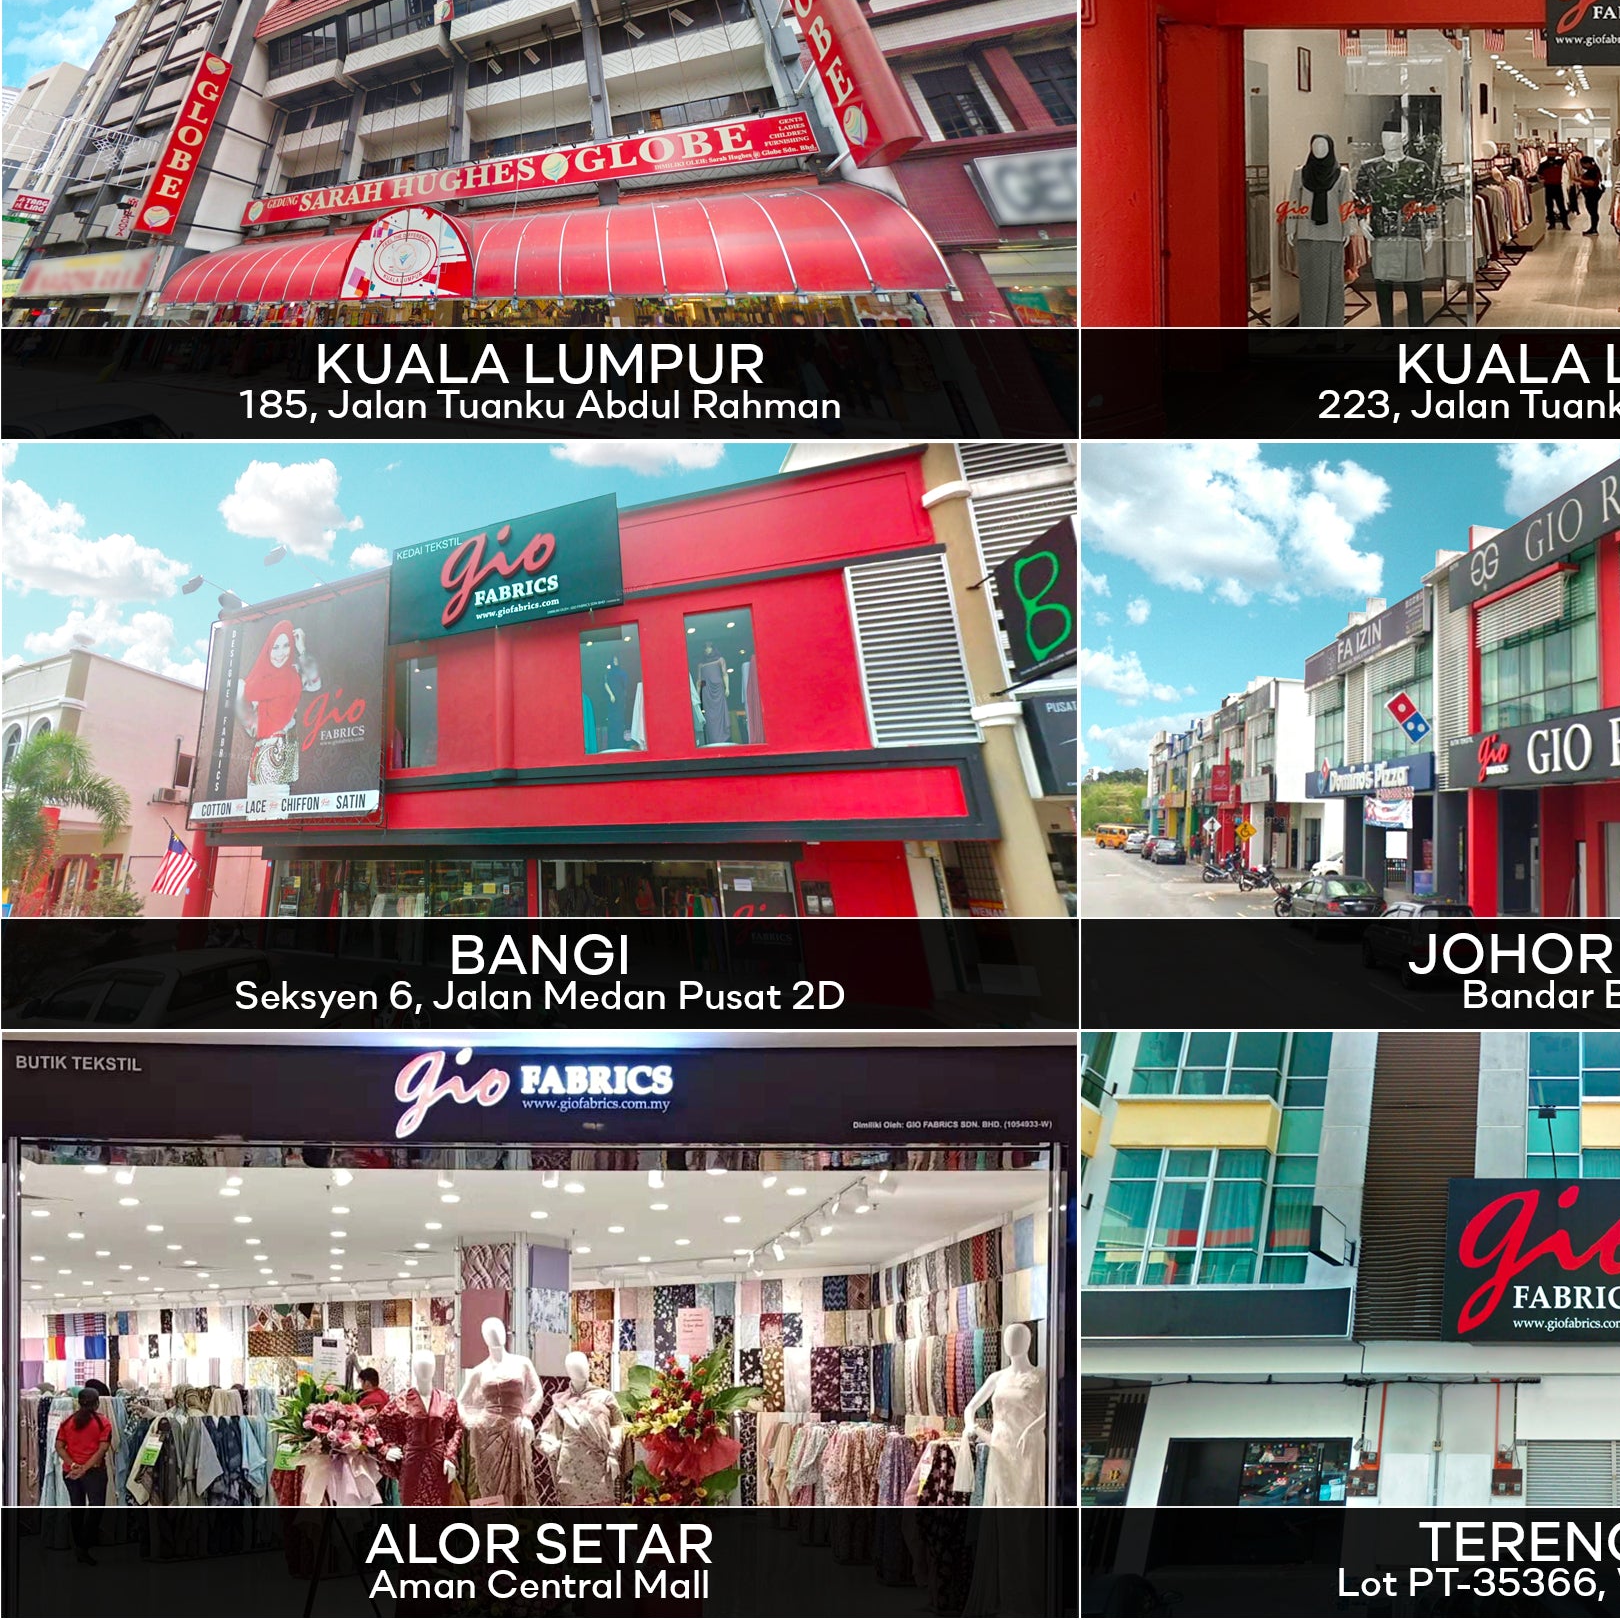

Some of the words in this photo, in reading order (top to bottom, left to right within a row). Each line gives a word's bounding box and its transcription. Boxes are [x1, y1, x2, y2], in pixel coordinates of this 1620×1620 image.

[778, 116, 803, 125] GENTS
[778, 123, 805, 132] LADIES
[156, 81, 219, 200] GLOBE
[764, 136, 810, 147] FURNISHING
[769, 129, 807, 140] CHILDREN
[574, 123, 753, 173] GLOBE
[708, 155, 727, 164] Sarah
[728, 153, 752, 163] Hughes
[761, 147, 782, 157] Globe
[266, 195, 298, 209] GEDUNG
[298, 181, 385, 213] SARAH
[390, 157, 535, 200] HUGHES
[1275, 200, 1310, 225] gio
[383, 273, 399, 283] KUALA
[1525, 498, 1583, 562] GIO
[396, 547, 423, 561] KEDAI
[424, 537, 462, 554] TEKSTIL
[440, 524, 557, 628] gio
[474, 574, 559, 608] FABRICS
[475, 598, 560, 620] www.giofabrics.com
[1337, 639, 1353, 663] FA
[1356, 619, 1382, 653] IZIN
[302, 688, 367, 753] gio
[319, 725, 365, 741] FABRICS
[1478, 733, 1510, 783] gio
[1527, 723, 1593, 775] GIO
[1329, 764, 1373, 792] Domino's
[1374, 761, 1410, 789] Pizza
[201, 802, 232, 817] COTTON
[245, 799, 266, 814] LACE
[281, 796, 320, 812] CHIFFON
[336, 794, 366, 810] SATIN
[16, 1055, 67, 1069] BUTIK
[71, 1056, 142, 1071] TEKSTIL
[395, 1047, 510, 1138] gio
[521, 1065, 674, 1094] FABRICS
[522, 1098, 671, 1112] www.giofabrics.com.my
[883, 1121, 904, 1129] Oleh:
[906, 1121, 921, 1129] GIO
[923, 1121, 958, 1129] FABRICS
[960, 1121, 980, 1129] SDN.
[982, 1121, 1002, 1129] BHD.
